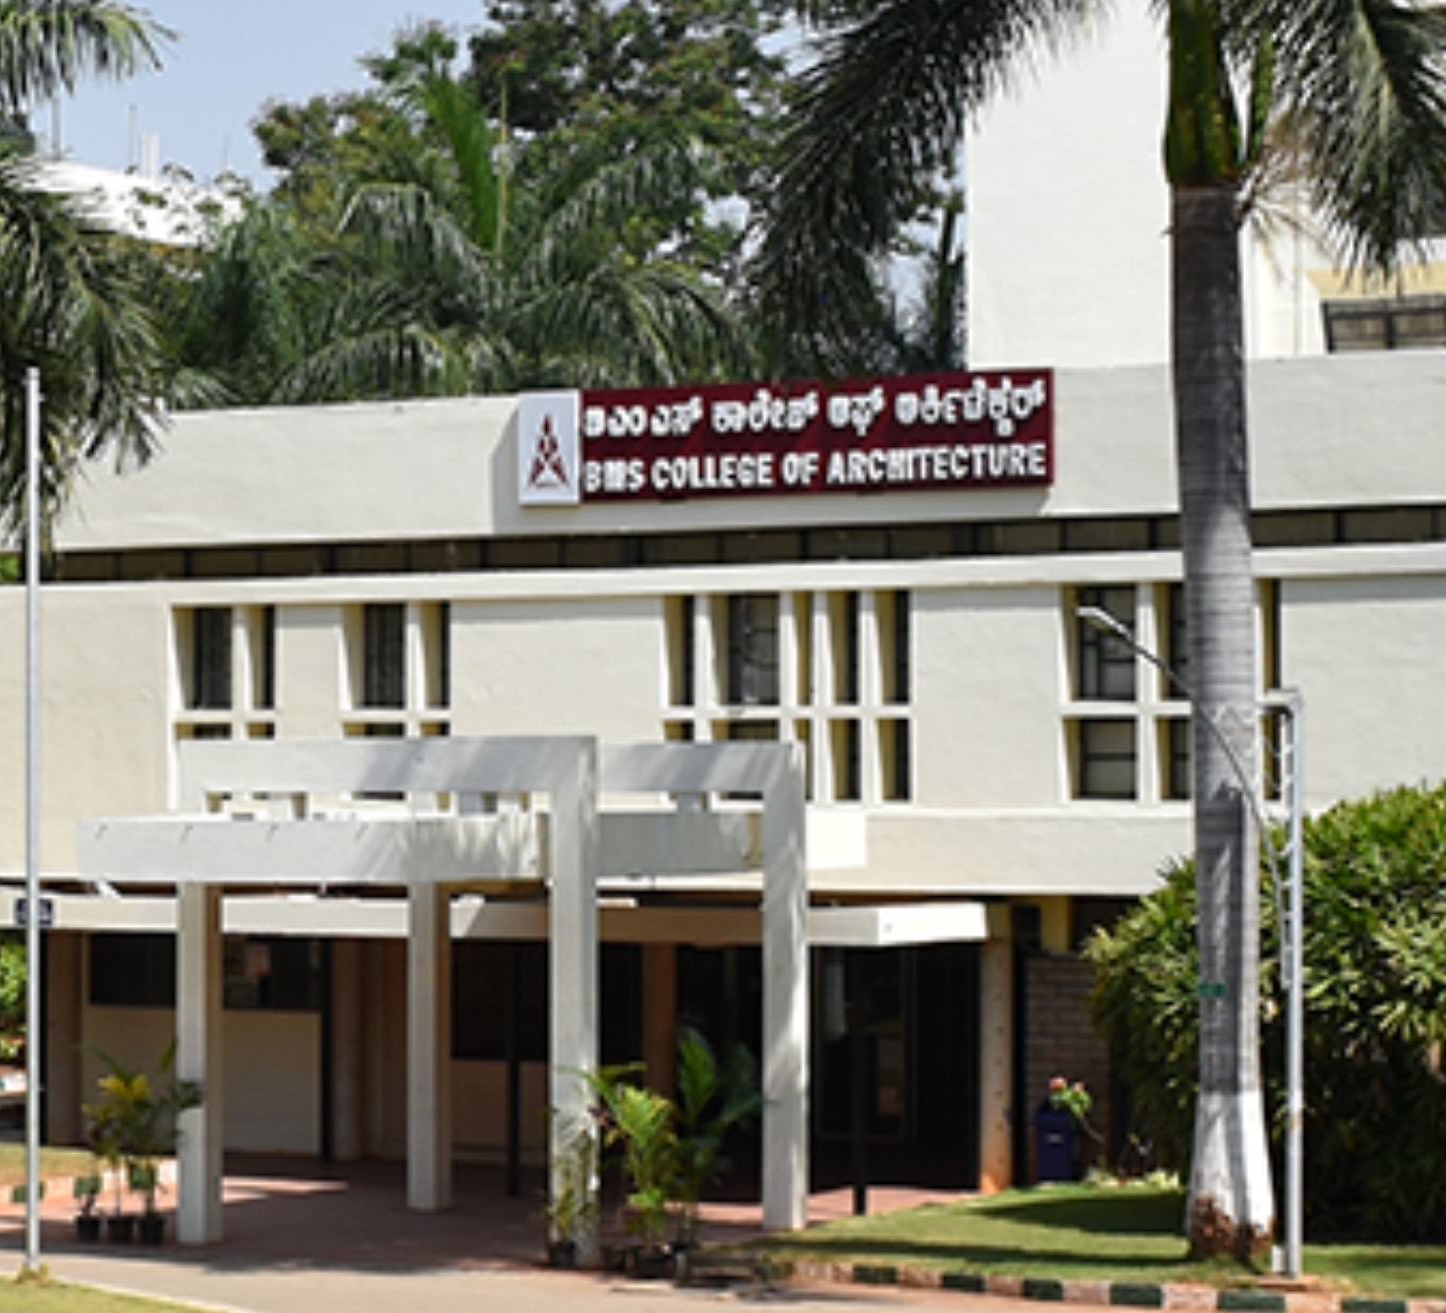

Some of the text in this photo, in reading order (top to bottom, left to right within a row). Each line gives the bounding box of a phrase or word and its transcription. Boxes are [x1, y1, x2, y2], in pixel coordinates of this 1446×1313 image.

[584, 443, 1047, 493] BMS COLLEGE OF ARCHITECTURE
